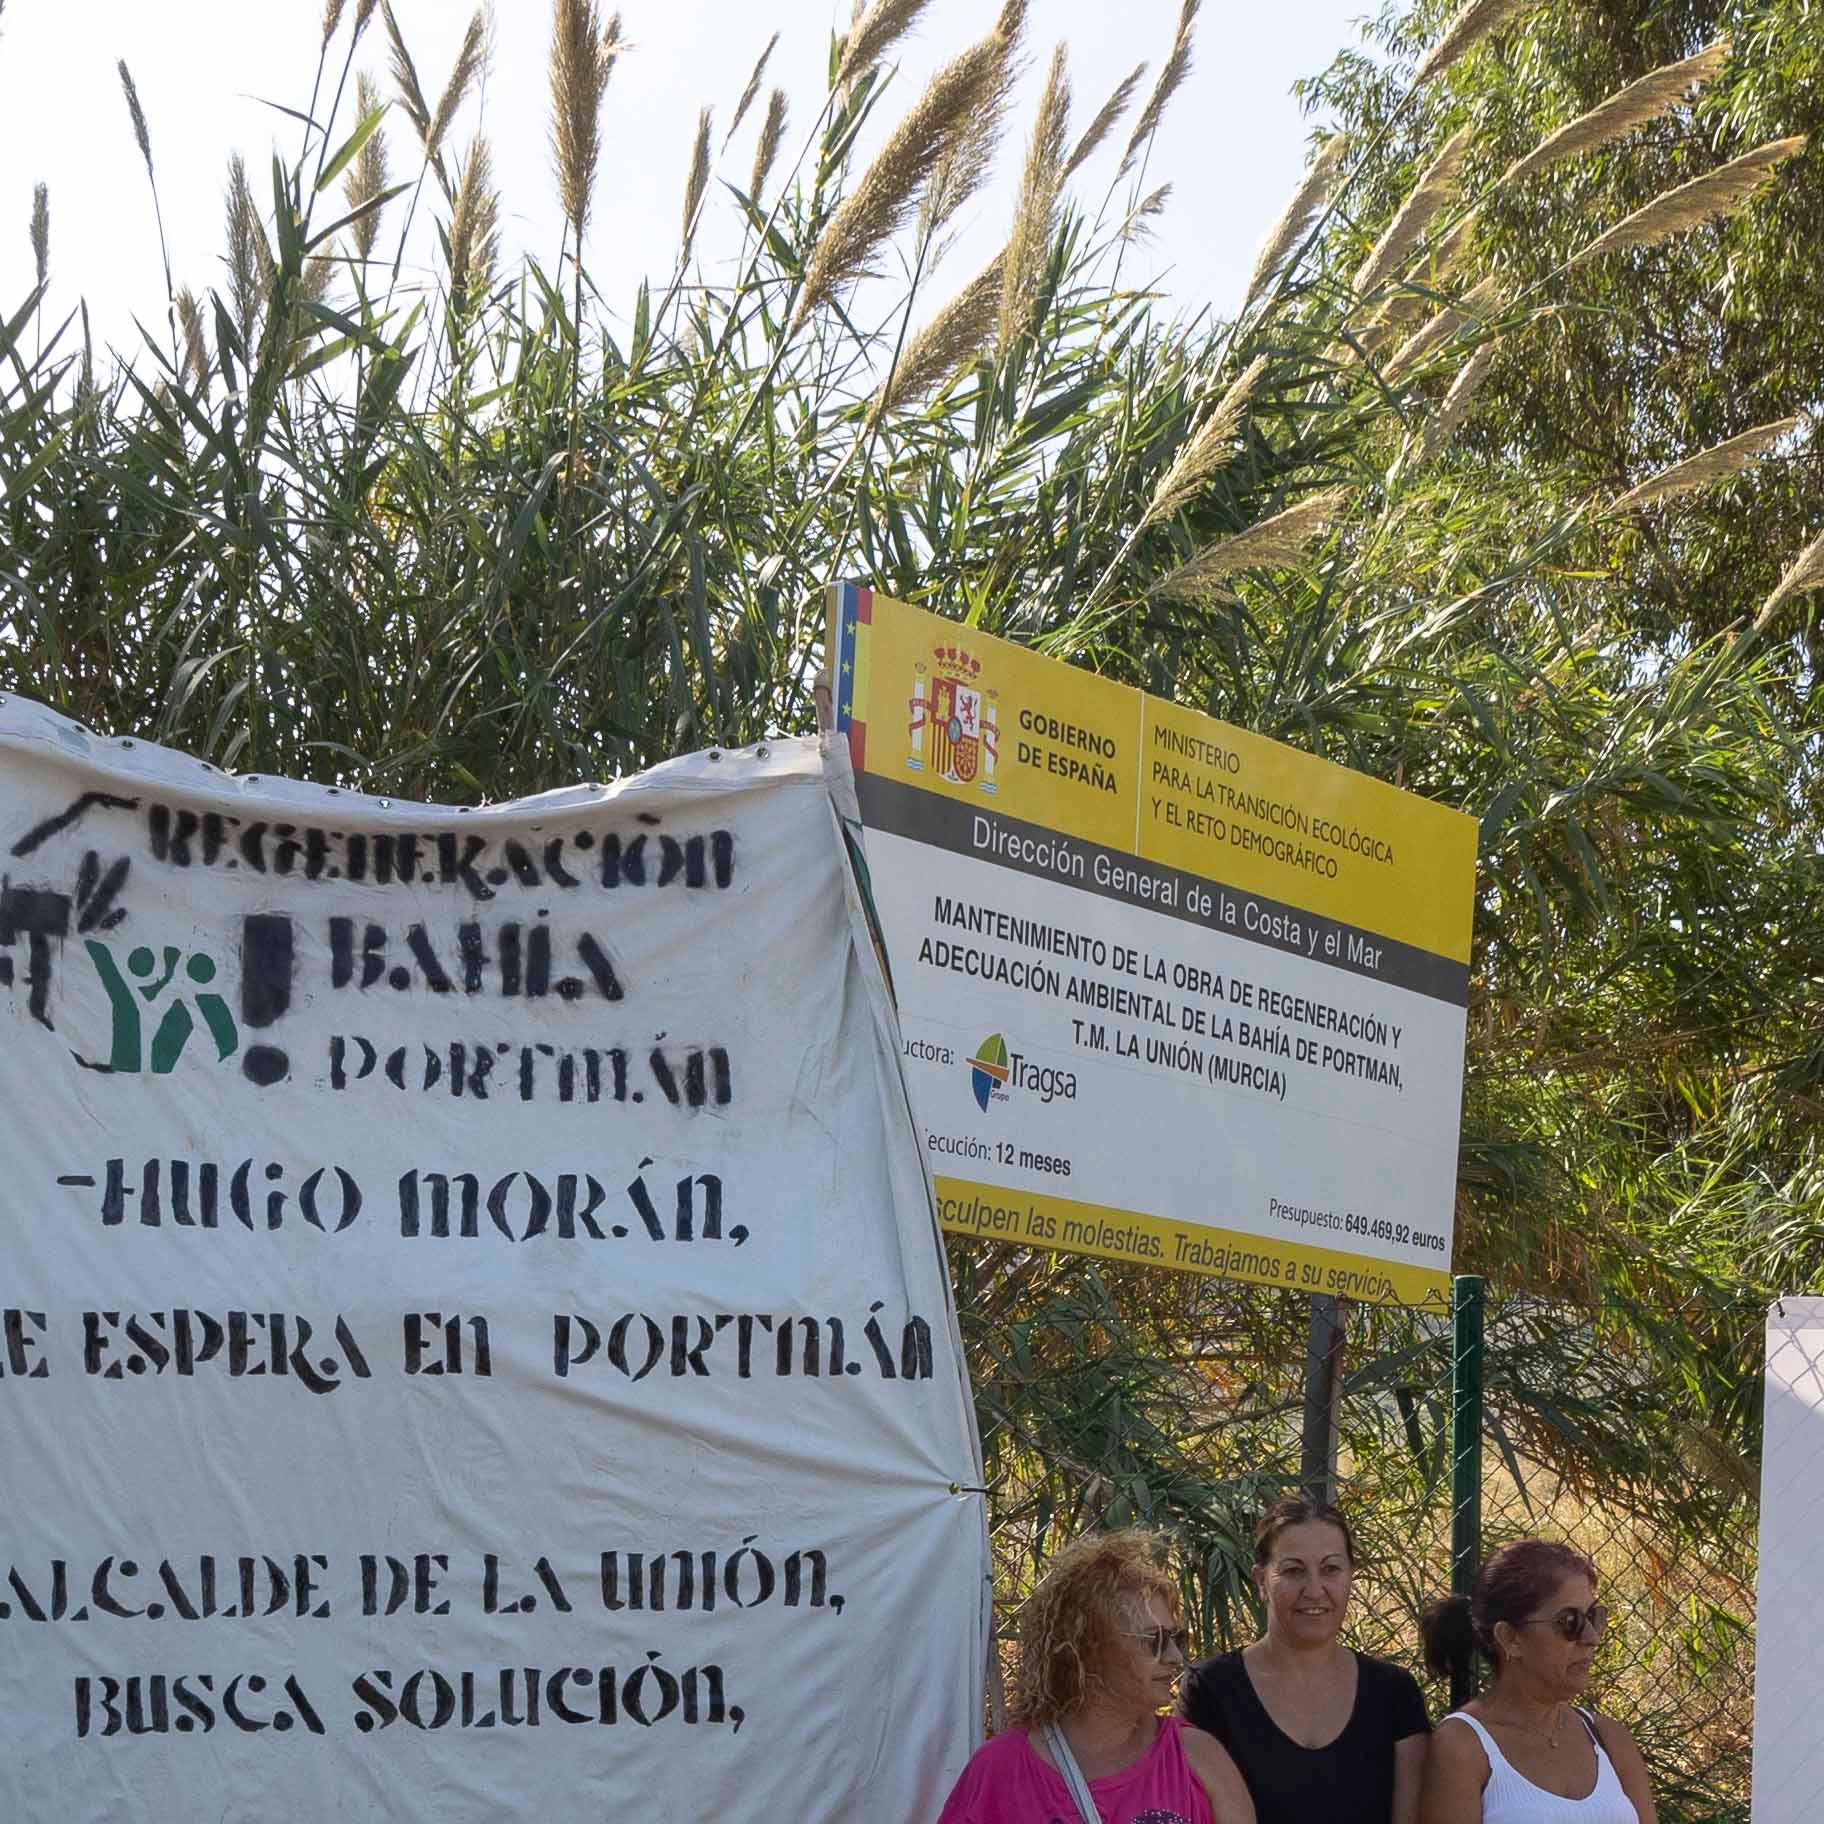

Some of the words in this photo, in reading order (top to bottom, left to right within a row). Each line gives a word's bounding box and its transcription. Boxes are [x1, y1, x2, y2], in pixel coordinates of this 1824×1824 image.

[1019, 743, 1041, 768] DE
[1048, 752, 1117, 793] ESPAÑA
[1020, 710, 1115, 758] GOBIERNO
[1155, 725, 1240, 774] MINISTERIO
[1152, 797, 1161, 818] Y
[1167, 802, 1182, 826] EL
[1187, 810, 1226, 840] RETO
[1231, 825, 1337, 878] DEMOGRÁFICO
[1153, 761, 1191, 792] PARA
[1197, 777, 1215, 801] LA
[1218, 784, 1309, 832] TRANSICIÓN
[1313, 819, 1393, 864] ECOLÓGICA
[974, 816, 1083, 877] Dirección
[1094, 855, 1178, 906] General
[1187, 885, 1211, 916] de
[1220, 893, 1235, 924] la
[1245, 904, 1300, 944] Costa
[1308, 931, 1319, 956] y
[1325, 930, 1340, 956] el
[1348, 934, 1382, 968] Mar
[328, 910, 624, 1001] BAHÍA
[935, 896, 1106, 965] MANTENIMIENTO
[1113, 946, 1137, 975] DE
[1144, 955, 1166, 984] LA
[1174, 964, 1224, 999] OBRA
[1230, 980, 1253, 1007] DE
[1259, 988, 1387, 1045] REGENERACIÓN
[1392, 1027, 1401, 1048] Y
[919, 938, 1059, 996] ADECUACIÓN
[1066, 977, 1175, 1027] AMBIENTAL
[1182, 1007, 1205, 1034] DE
[1212, 1015, 1233, 1042] LA
[1239, 1023, 1290, 1058] BAHÍA
[1296, 1038, 1318, 1065] DE
[1323, 1046, 1402, 1090] PORTMAN,
[330, 1032, 731, 1109] PORTMÁN
[1010, 1054, 1076, 1103] Tragsa
[1072, 1020, 1108, 1051] T.M.
[1117, 1031, 1139, 1059] LA
[1147, 1038, 1203, 1074] UNIÓN
[1209, 1055, 1286, 1101] (MURCIA)
[925, 1129, 991, 1160] ecución:
[996, 1142, 1014, 1165] 12
[1020, 1152, 1070, 1176] meses
[399, 1157, 749, 1247] MORÁN,
[1270, 1198, 1344, 1231] Presupuesto:
[1346, 1214, 1409, 1244] 649.469,92
[1412, 1230, 1445, 1251] euros
[1026, 1207, 1056, 1238] las
[1063, 1221, 1163, 1257] molestias.
[1176, 1235, 1279, 1276] Trabajamos
[1285, 1262, 1296, 1281] a
[1301, 1264, 1322, 1285] su
[83, 1310, 371, 1394] ESPERA
[404, 1313, 491, 1376] EN
[554, 1301, 933, 1382] PORTMÁN
[360, 1554, 450, 1615] DE
[483, 1554, 572, 1613] LA
[601, 1535, 845, 1615] UNIÓN,
[75, 1675, 325, 1737] BUSCA
[352, 1651, 744, 1733] SOLUCIÓN,
